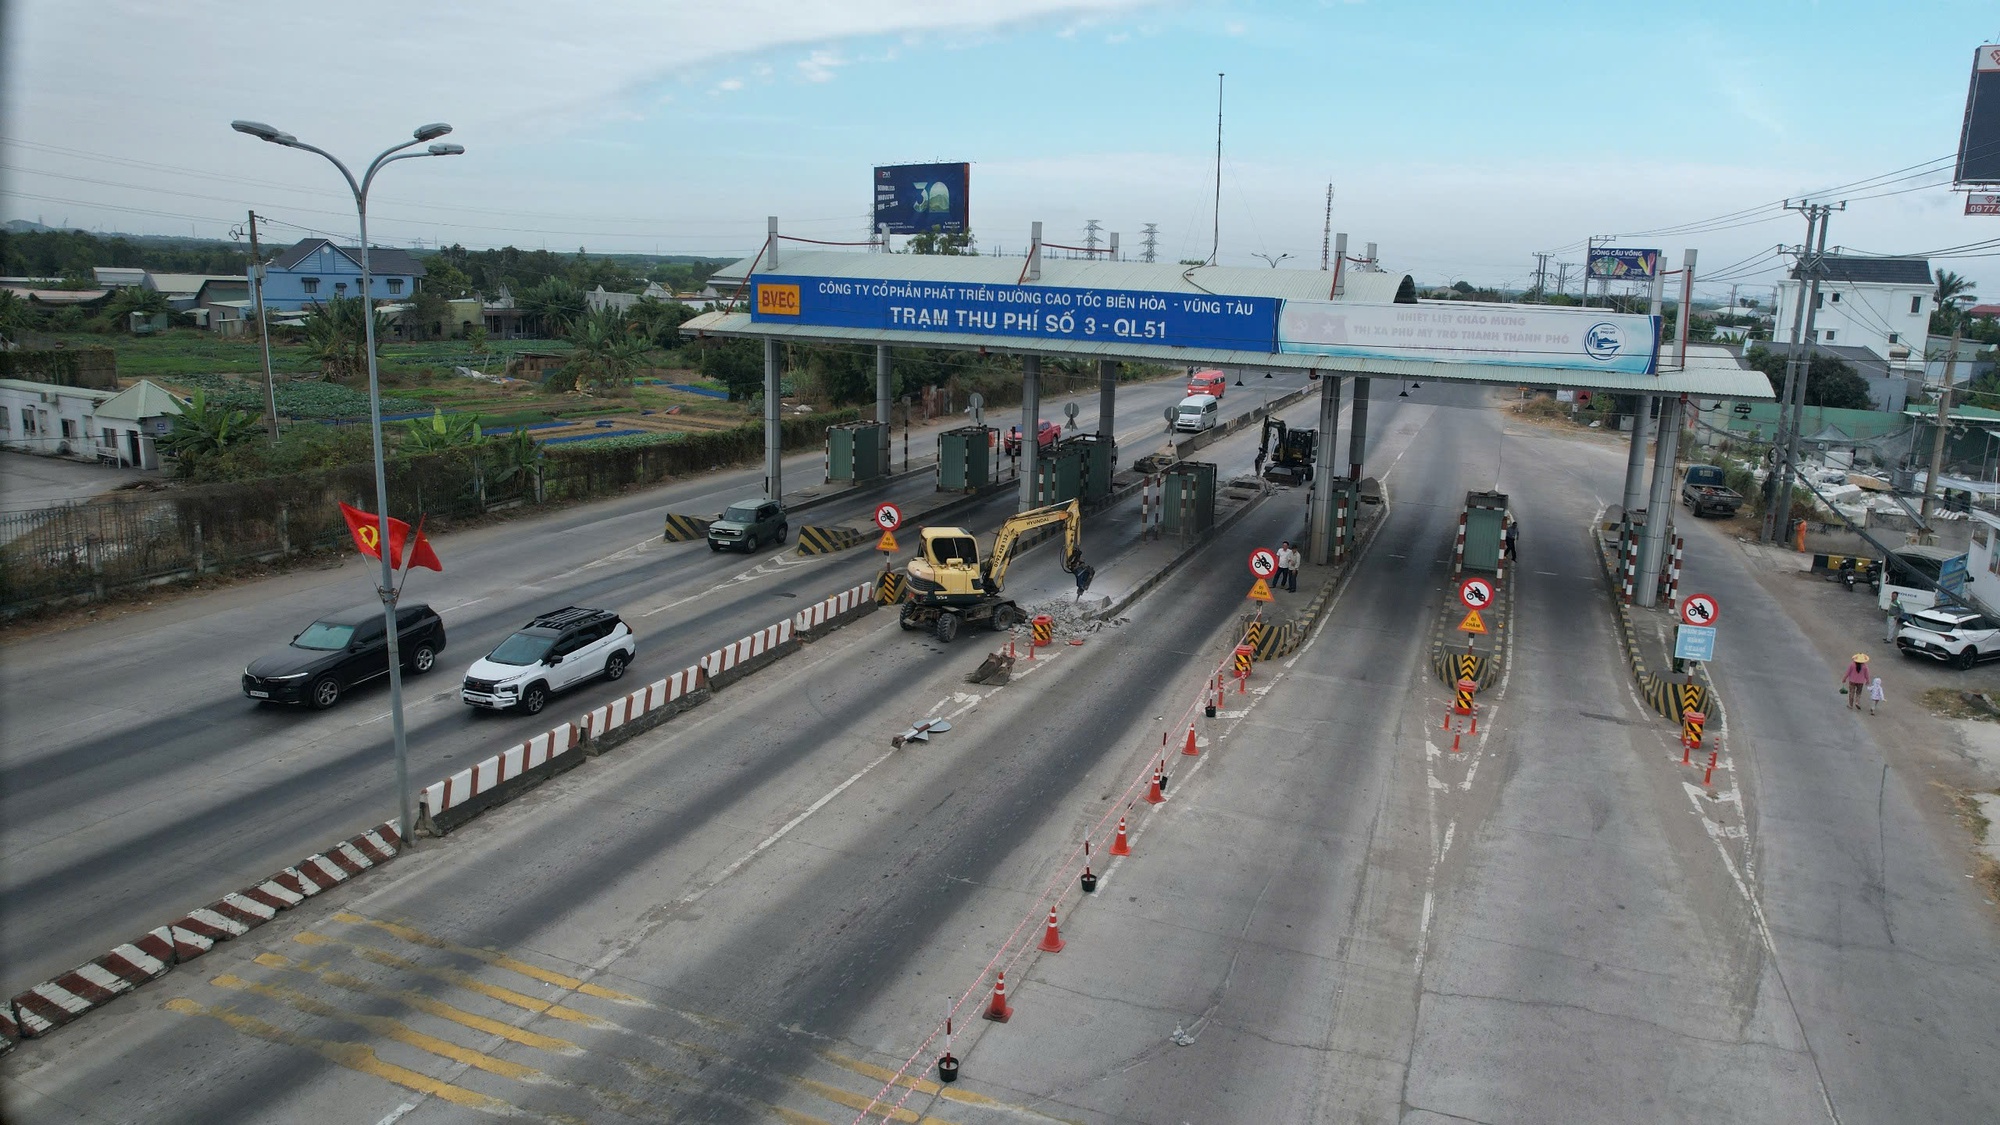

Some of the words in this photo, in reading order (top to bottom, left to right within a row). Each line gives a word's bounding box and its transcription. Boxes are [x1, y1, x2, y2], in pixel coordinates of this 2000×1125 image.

[762, 290, 796, 309] BVEC
[819, 280, 851, 295] CÔNG
[855, 284, 870, 295] TY
[872, 279, 888, 297] CỔ
[890, 281, 921, 299] PHẦN
[924, 285, 955, 300] PHÁT
[959, 285, 994, 301] TRIỂN
[997, 289, 1042, 305] ĐƯỜNG
[1045, 293, 1071, 306] CAO
[1076, 290, 1102, 307] TỐC
[1106, 293, 1136, 309] BIÊN
[1139, 294, 1167, 310] HÒA
[1183, 298, 1221, 314] VŨNG
[1225, 300, 1254, 316] TÀU
[890, 306, 949, 329] TRẠM
[955, 309, 996, 329] THU
[1003, 310, 1039, 331] PHÍ
[1045, 309, 1076, 334] SỐ
[1084, 317, 1096, 335] 3
[1114, 318, 1165, 338] QL51
[1026, 517, 1050, 526] HYUNDAI
